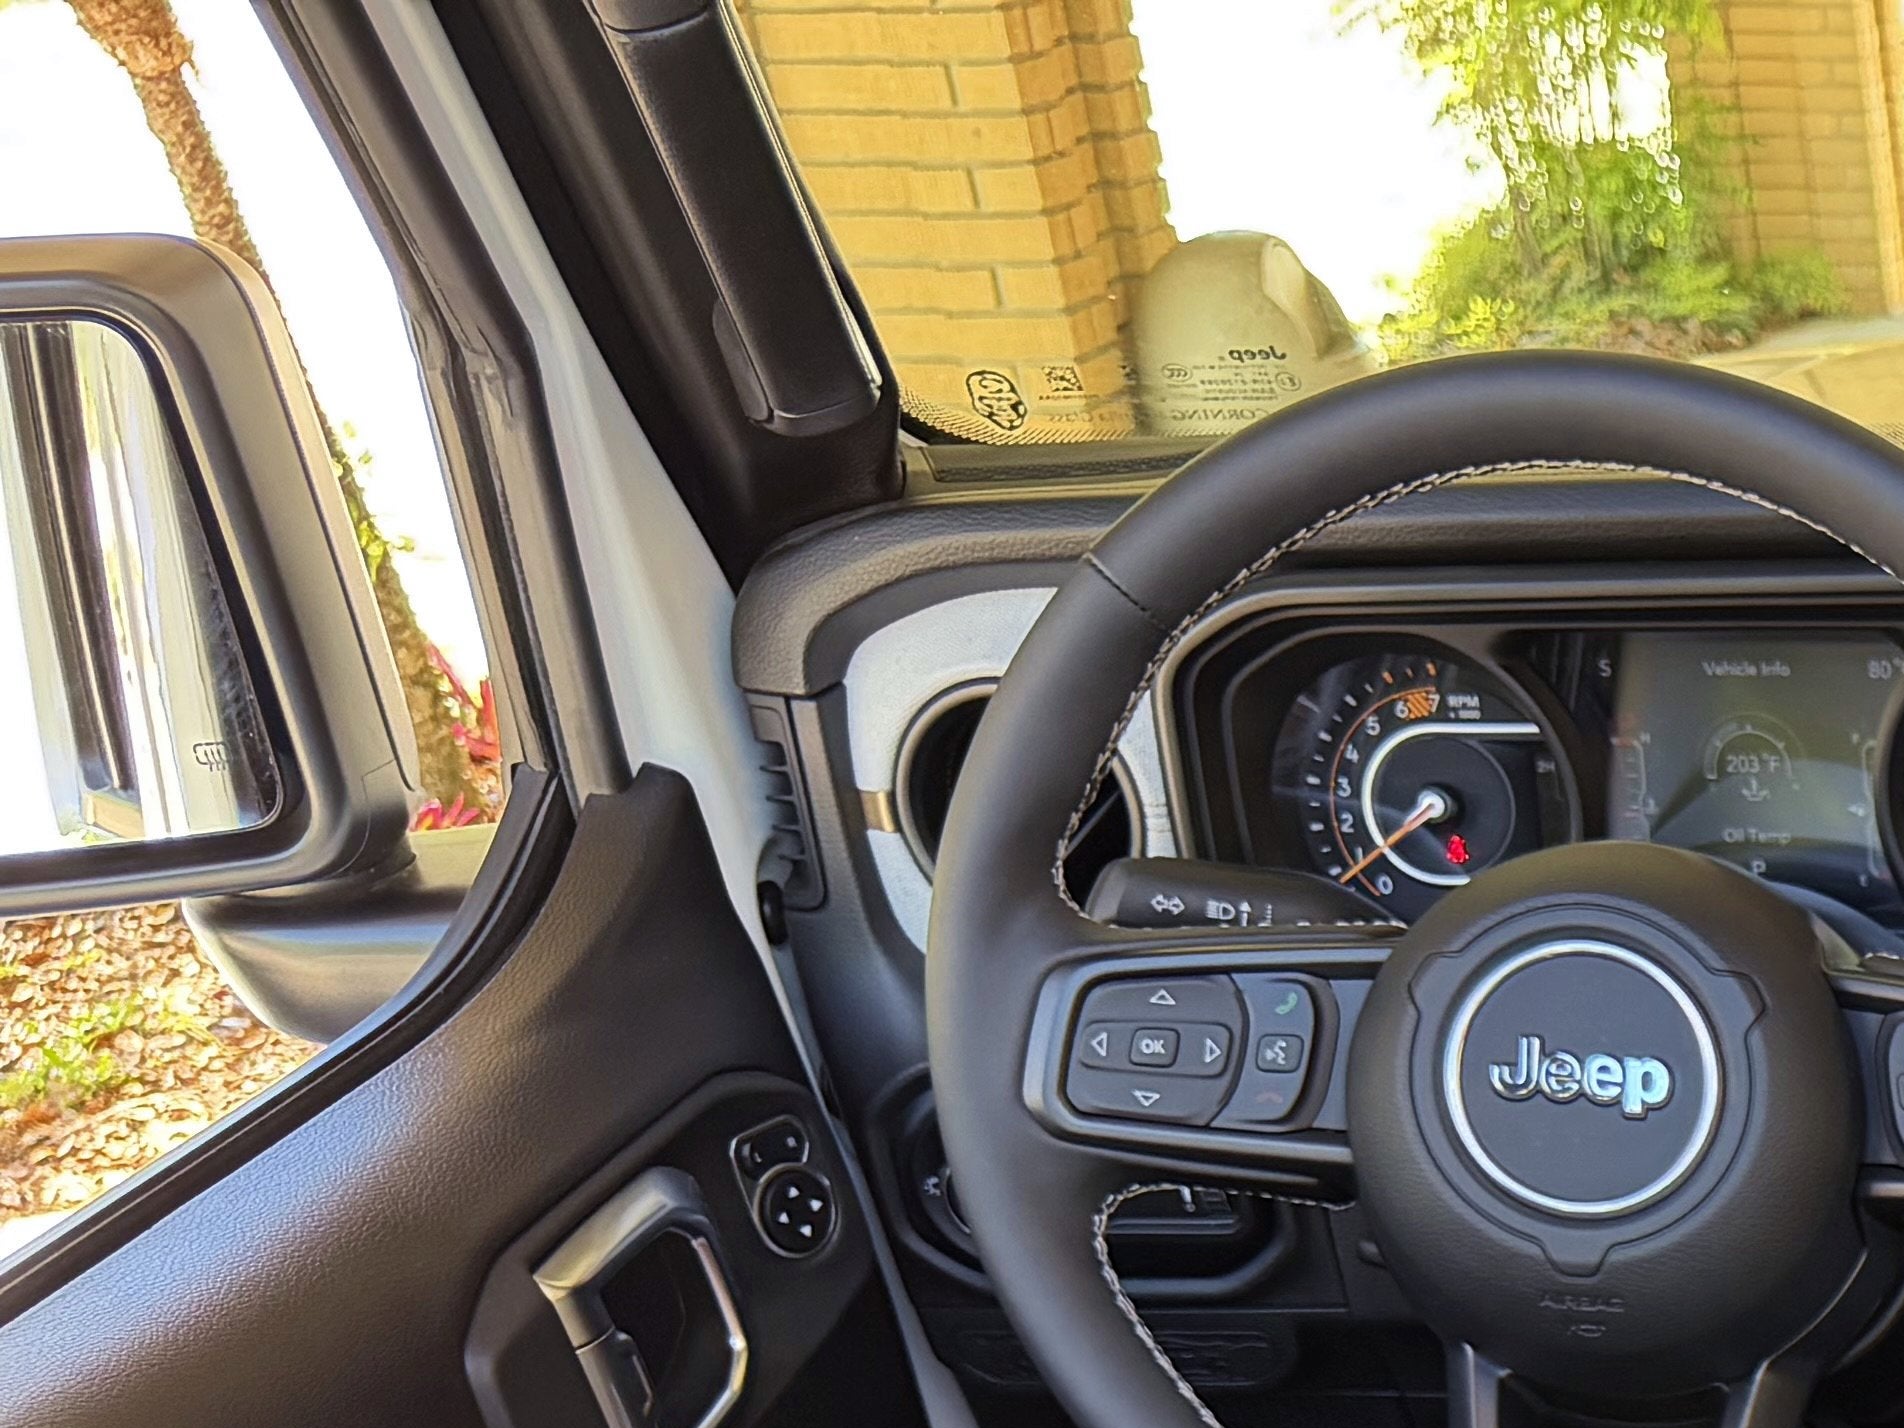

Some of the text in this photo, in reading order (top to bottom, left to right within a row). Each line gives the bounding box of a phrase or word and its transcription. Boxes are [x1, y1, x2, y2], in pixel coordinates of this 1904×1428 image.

[1702, 661, 1791, 676] Vehicle Info
[1394, 699, 1409, 719] 6
[1429, 693, 1440, 713] 7
[1447, 693, 1481, 708] RPM
[1366, 715, 1381, 736] 5
[1344, 744, 1359, 763] 4
[1726, 755, 1760, 774] 203
[1337, 776, 1351, 797] 3
[1341, 811, 1354, 833] 2
[1374, 876, 1394, 896] 0
[1140, 1037, 1167, 1055] OK
[1488, 1034, 1676, 1121] Jeep
